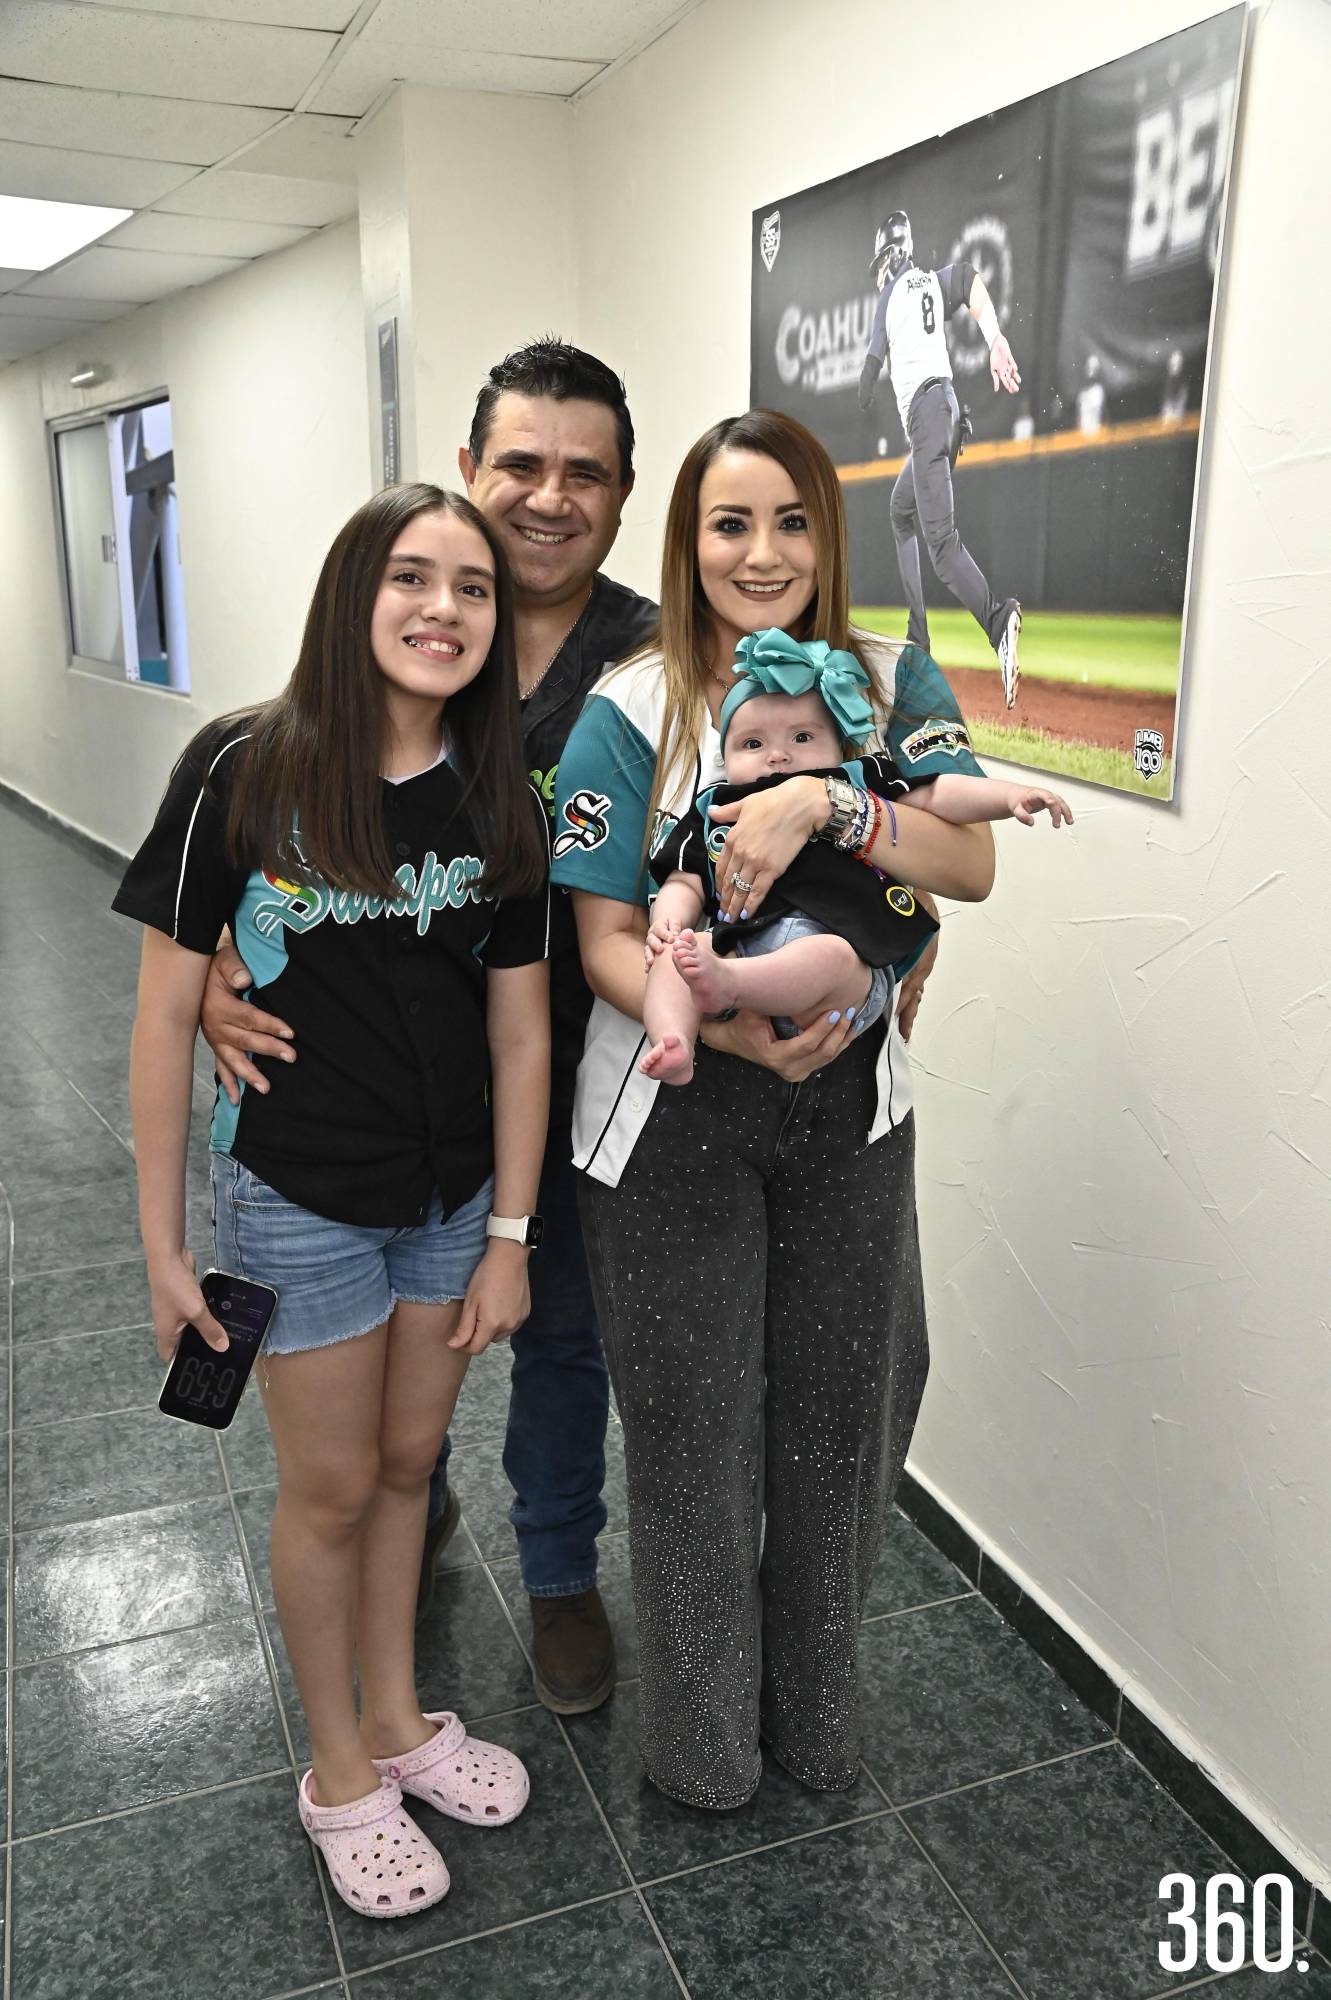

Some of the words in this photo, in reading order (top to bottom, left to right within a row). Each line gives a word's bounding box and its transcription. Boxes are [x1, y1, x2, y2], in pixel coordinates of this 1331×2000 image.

[921, 291, 936, 335] 8
[1135, 729, 1164, 752] LMB
[1136, 747, 1162, 774] 100
[176, 1356, 237, 1410] 6:59
